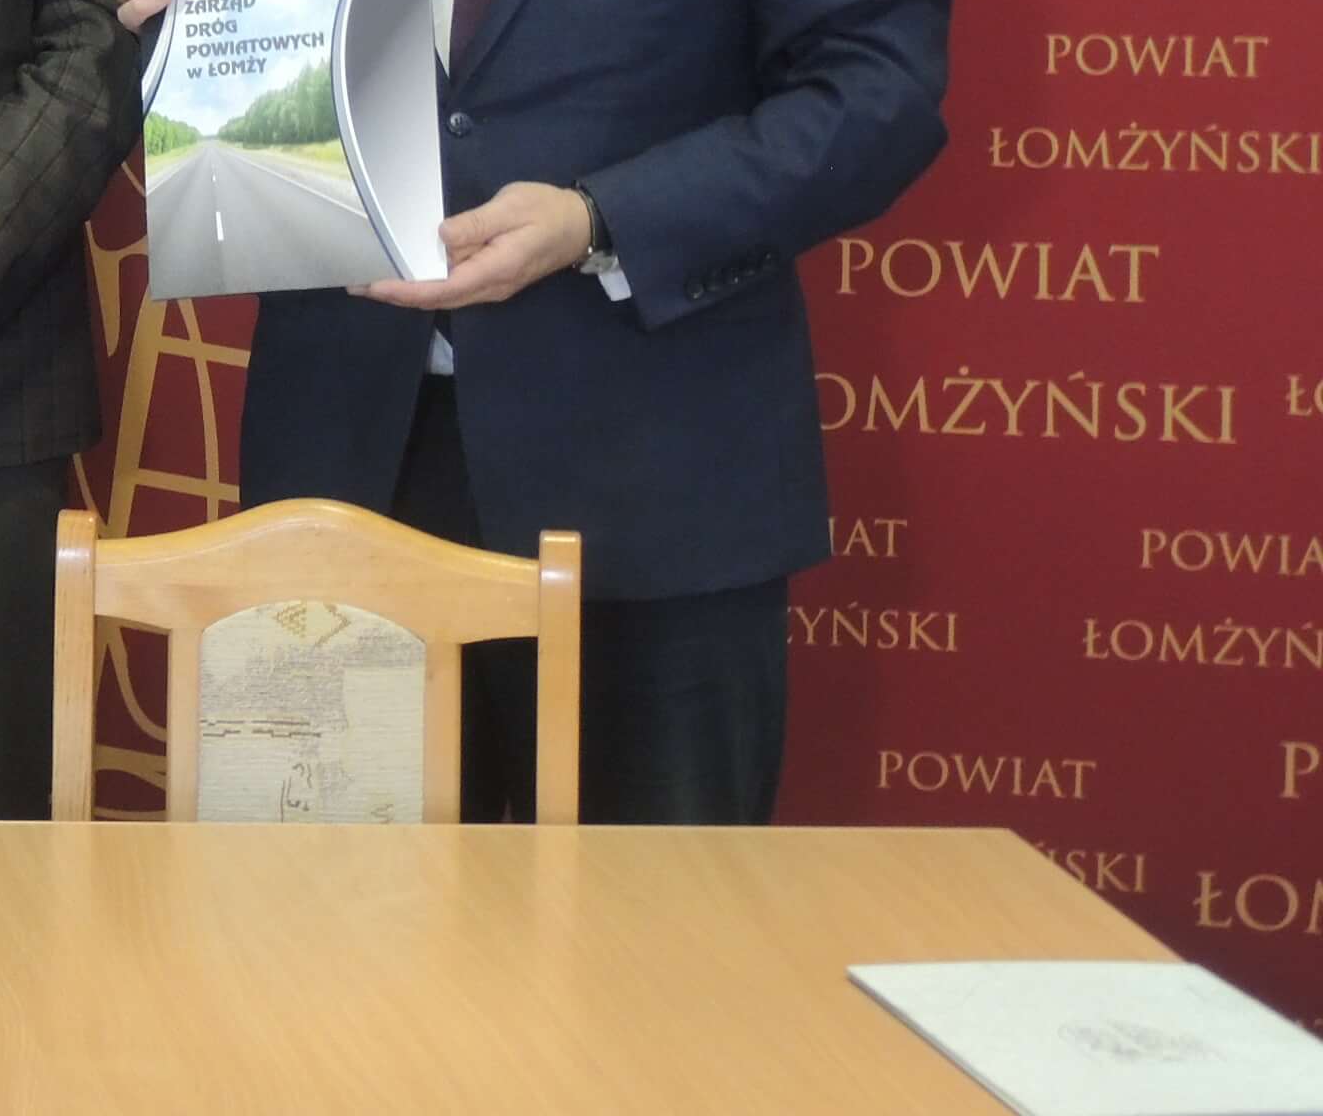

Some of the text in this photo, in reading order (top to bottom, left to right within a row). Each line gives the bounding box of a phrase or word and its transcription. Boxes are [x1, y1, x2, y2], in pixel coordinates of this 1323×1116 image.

[185, 17, 238, 38] DRÓG
[186, 31, 325, 59] POWIATOWYCH
[208, 55, 267, 78] ŁOMŻY
[1044, 34, 1269, 78] POWIAT
[989, 121, 1323, 174] ŁOMŻYŃSKI
[835, 237, 1161, 304] POWIAT
[814, 366, 1237, 446] OMŻYŃSKI
[1139, 528, 1323, 579] POWIA
[1082, 617, 1323, 670] ŁOMŻYŃ
[877, 748, 1097, 800] POWIAT
